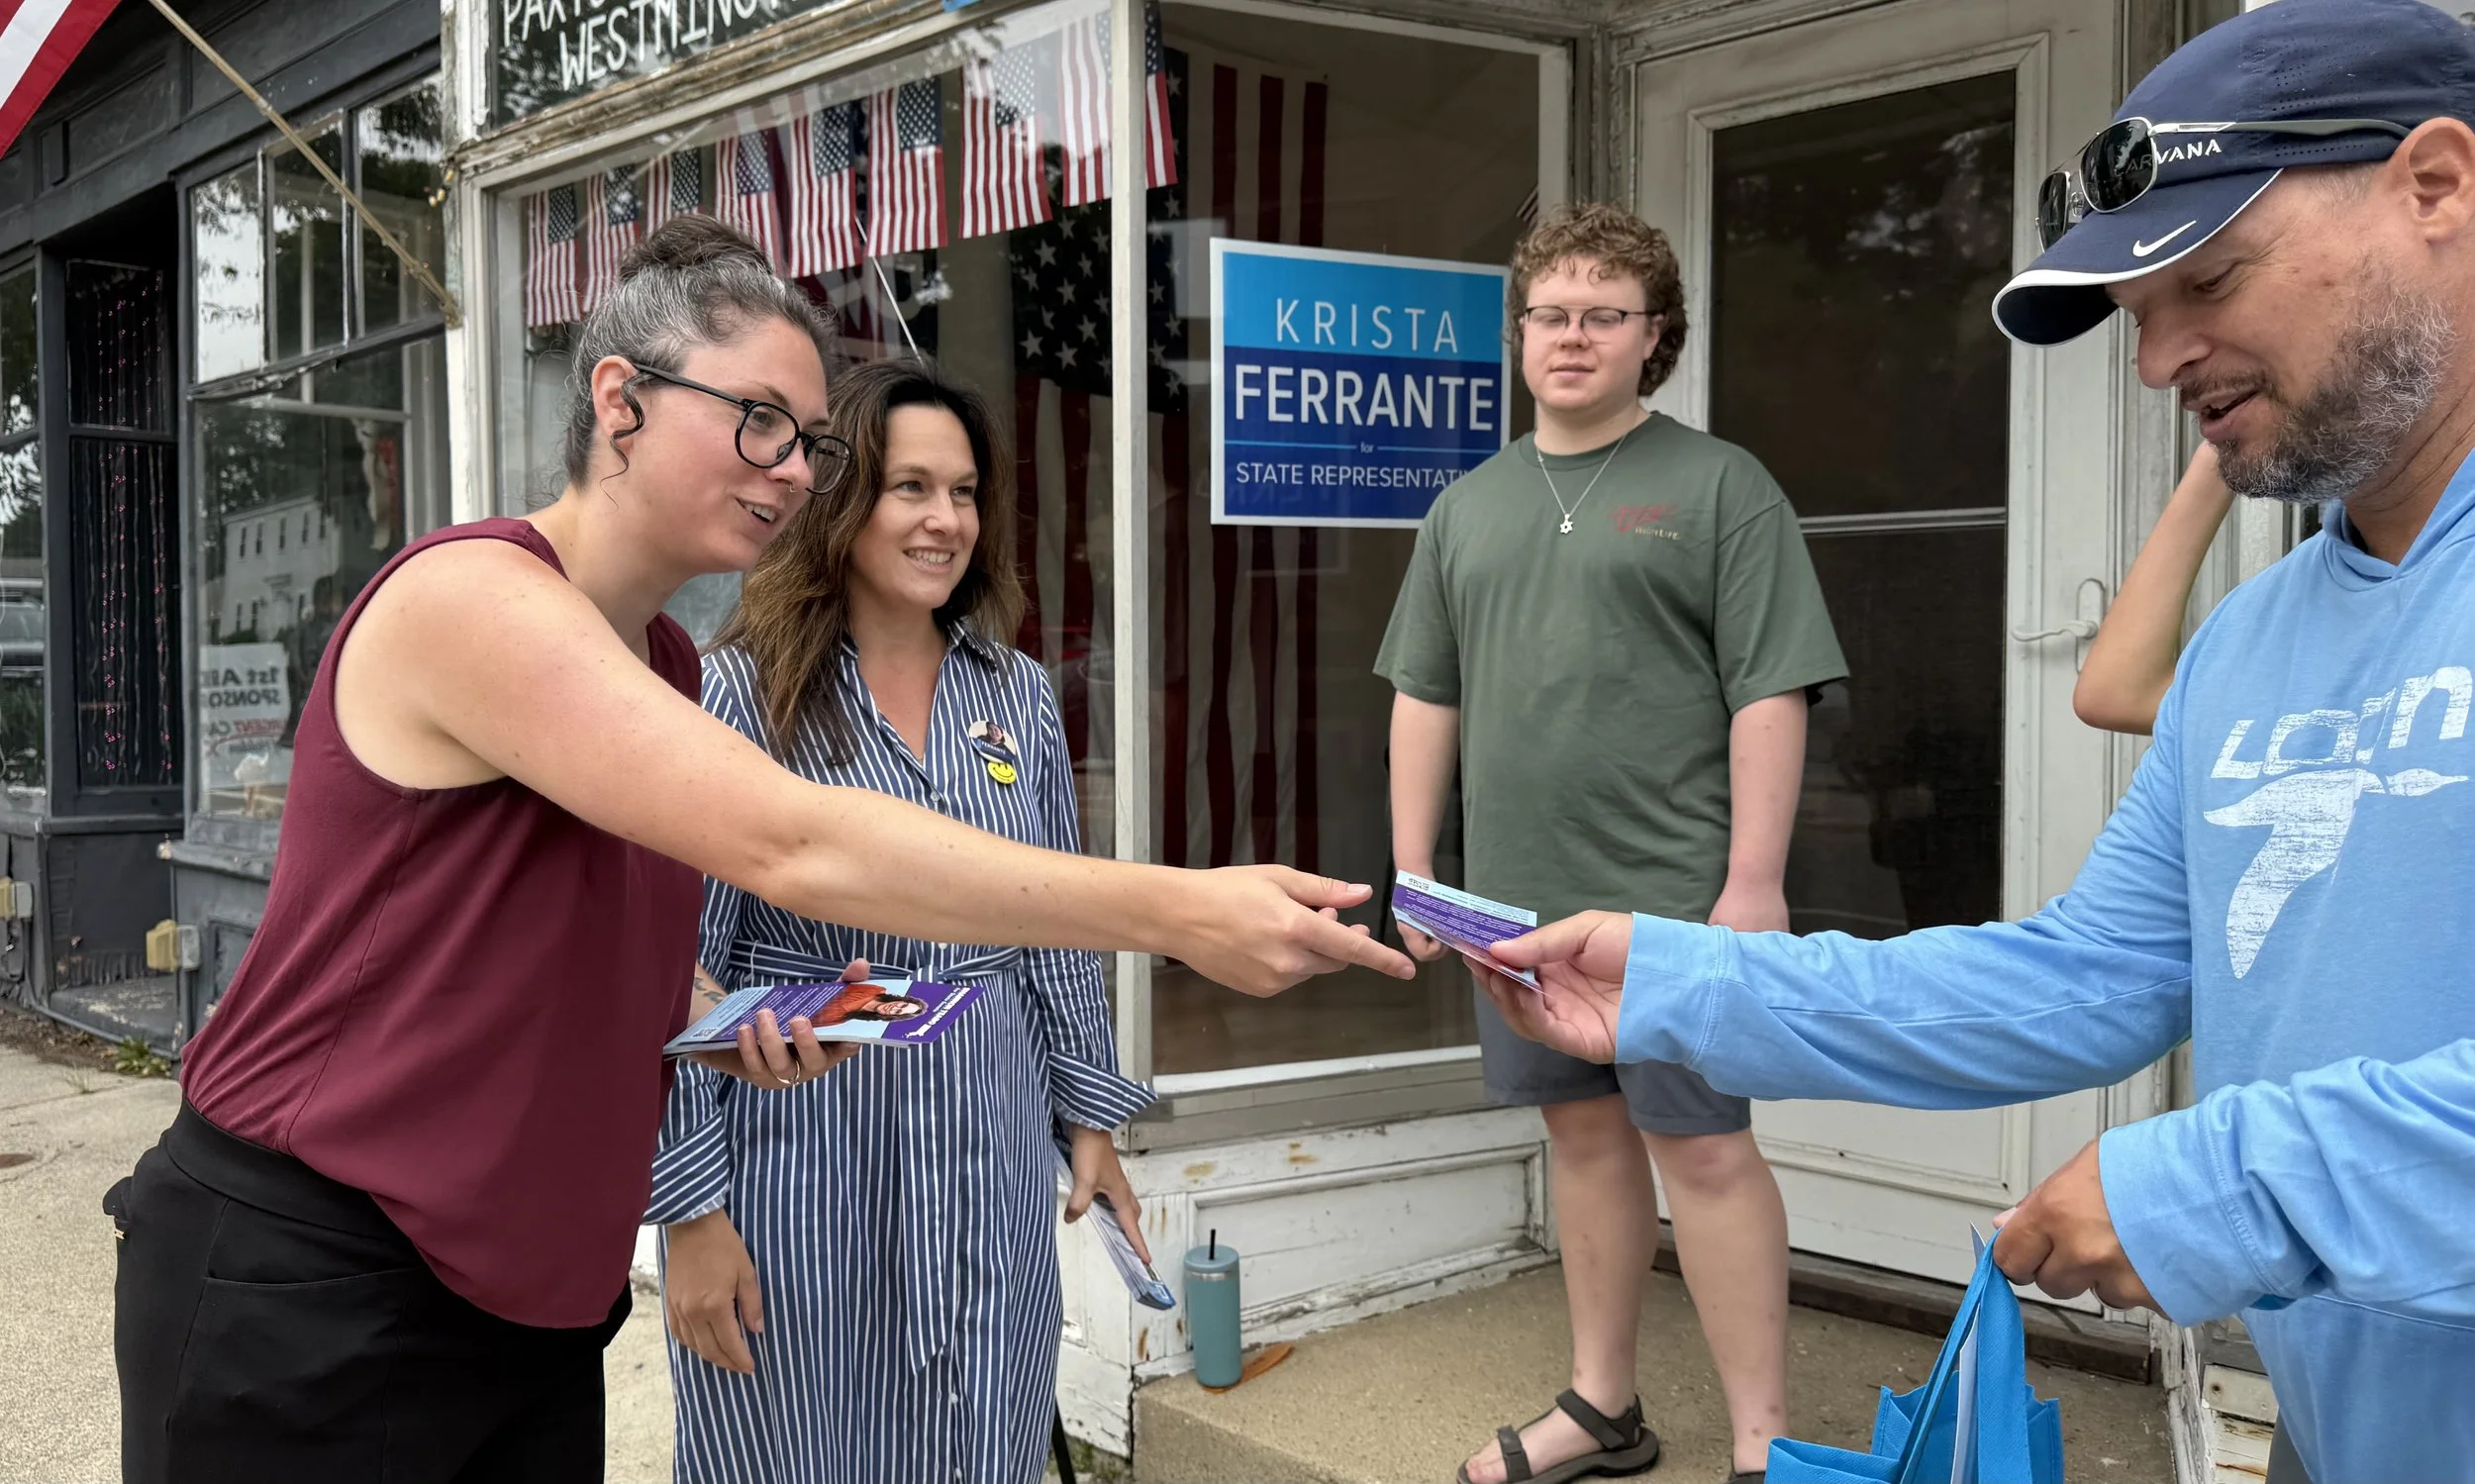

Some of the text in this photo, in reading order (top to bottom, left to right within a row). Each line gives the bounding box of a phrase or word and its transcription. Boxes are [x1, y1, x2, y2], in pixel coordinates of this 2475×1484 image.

[503, 0, 606, 48] PAX
[559, 0, 778, 91] WESTMIN
[1276, 298, 1458, 353] KRISTA
[1235, 363, 1494, 431] FERRANTE
[1360, 441, 1374, 453] for
[1236, 461, 1467, 488] STATE REPRESENTAT
